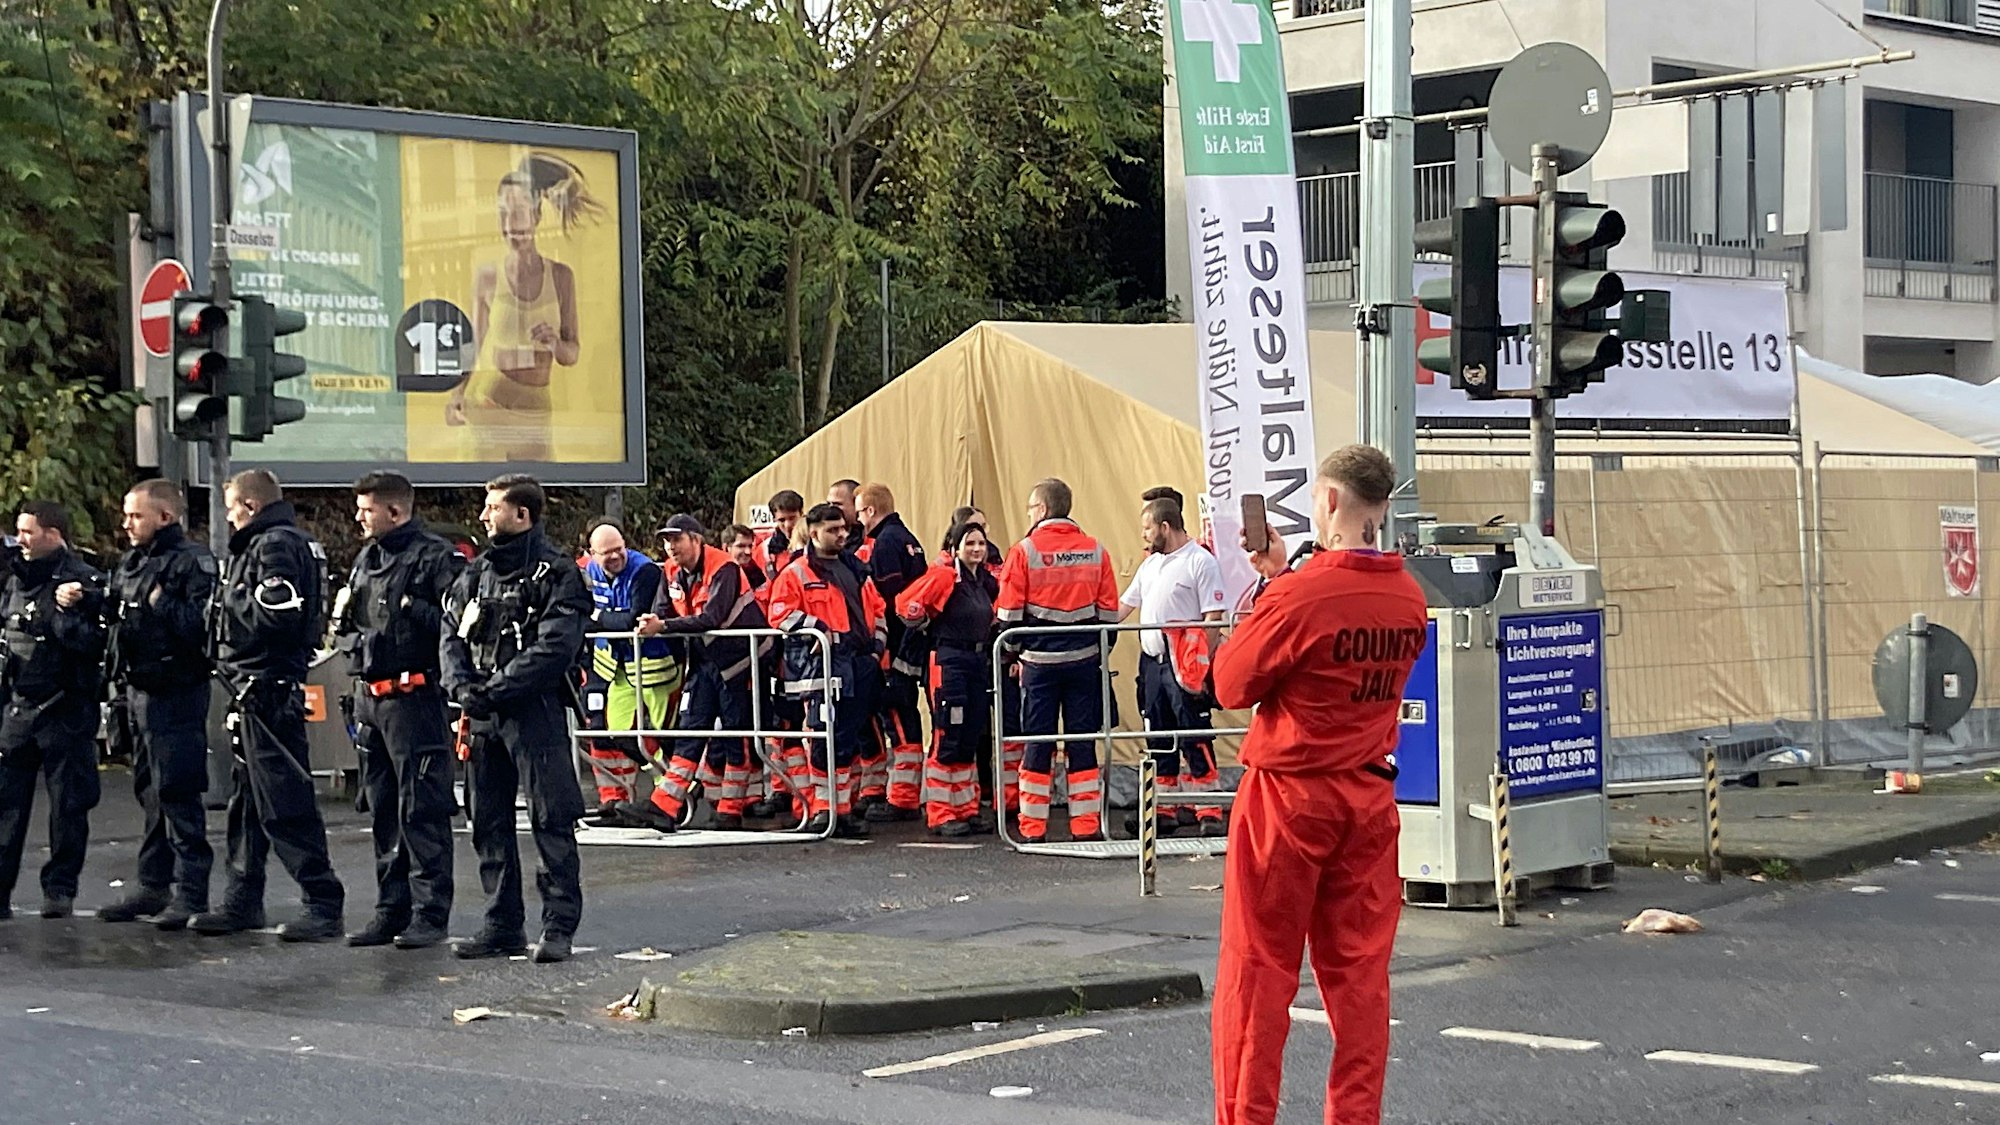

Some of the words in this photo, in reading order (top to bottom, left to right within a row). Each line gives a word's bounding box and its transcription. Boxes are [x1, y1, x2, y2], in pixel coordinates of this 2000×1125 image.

[230, 228, 276, 247] Dasselstr.
[292, 251, 361, 266] COLOGNE
[237, 272, 284, 287] JETZT
[318, 311, 389, 328] SICHERN
[1745, 333, 1781, 373] 13
[1056, 553, 1095, 562] Malteser
[1507, 625, 1528, 641] Ihre
[1530, 621, 1583, 640] kompakte
[1507, 639, 1595, 662] Lichtversorgung!
[1350, 667, 1397, 703] JAIL
[1515, 755, 1542, 773] 0800
[1547, 753, 1567, 769] 092
[1568, 750, 1581, 766] 99
[1582, 748, 1596, 763] 70
